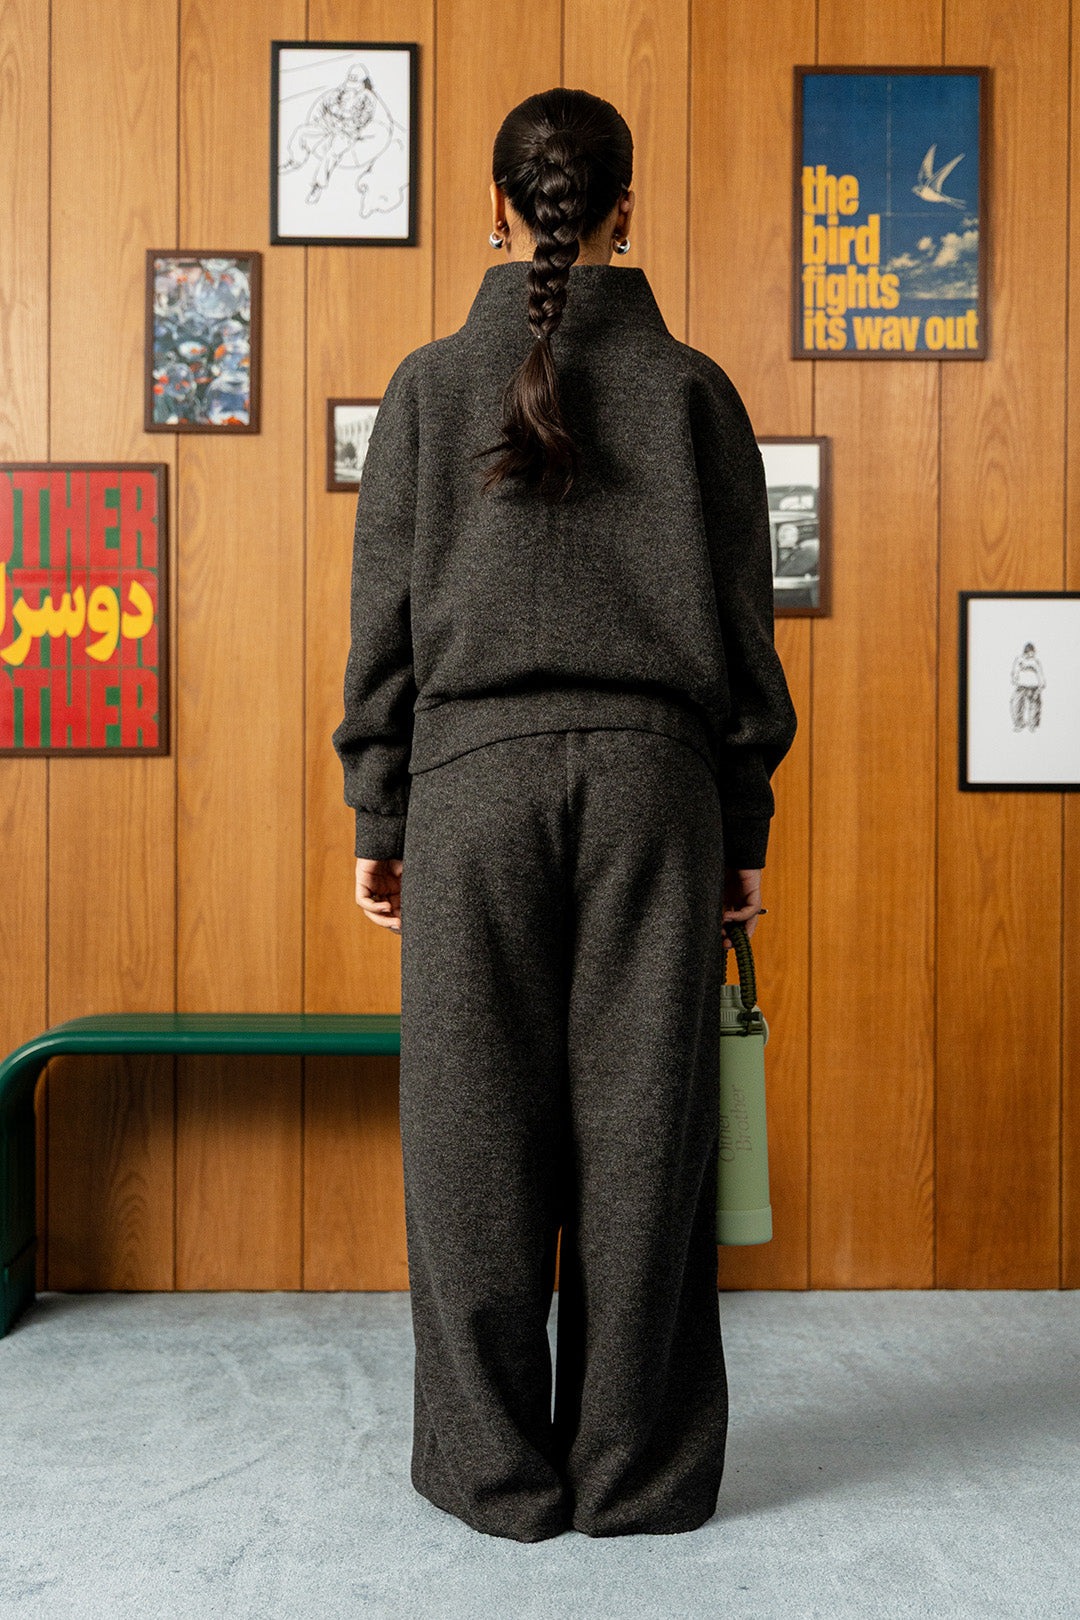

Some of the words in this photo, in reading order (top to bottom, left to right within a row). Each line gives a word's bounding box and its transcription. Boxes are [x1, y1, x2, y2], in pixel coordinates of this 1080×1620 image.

[802, 165, 859, 215] the
[802, 214, 880, 265] bird
[802, 265, 900, 316] fights
[803, 309, 847, 350] its
[925, 309, 978, 350] out
[729, 1086, 752, 1151] Brother
